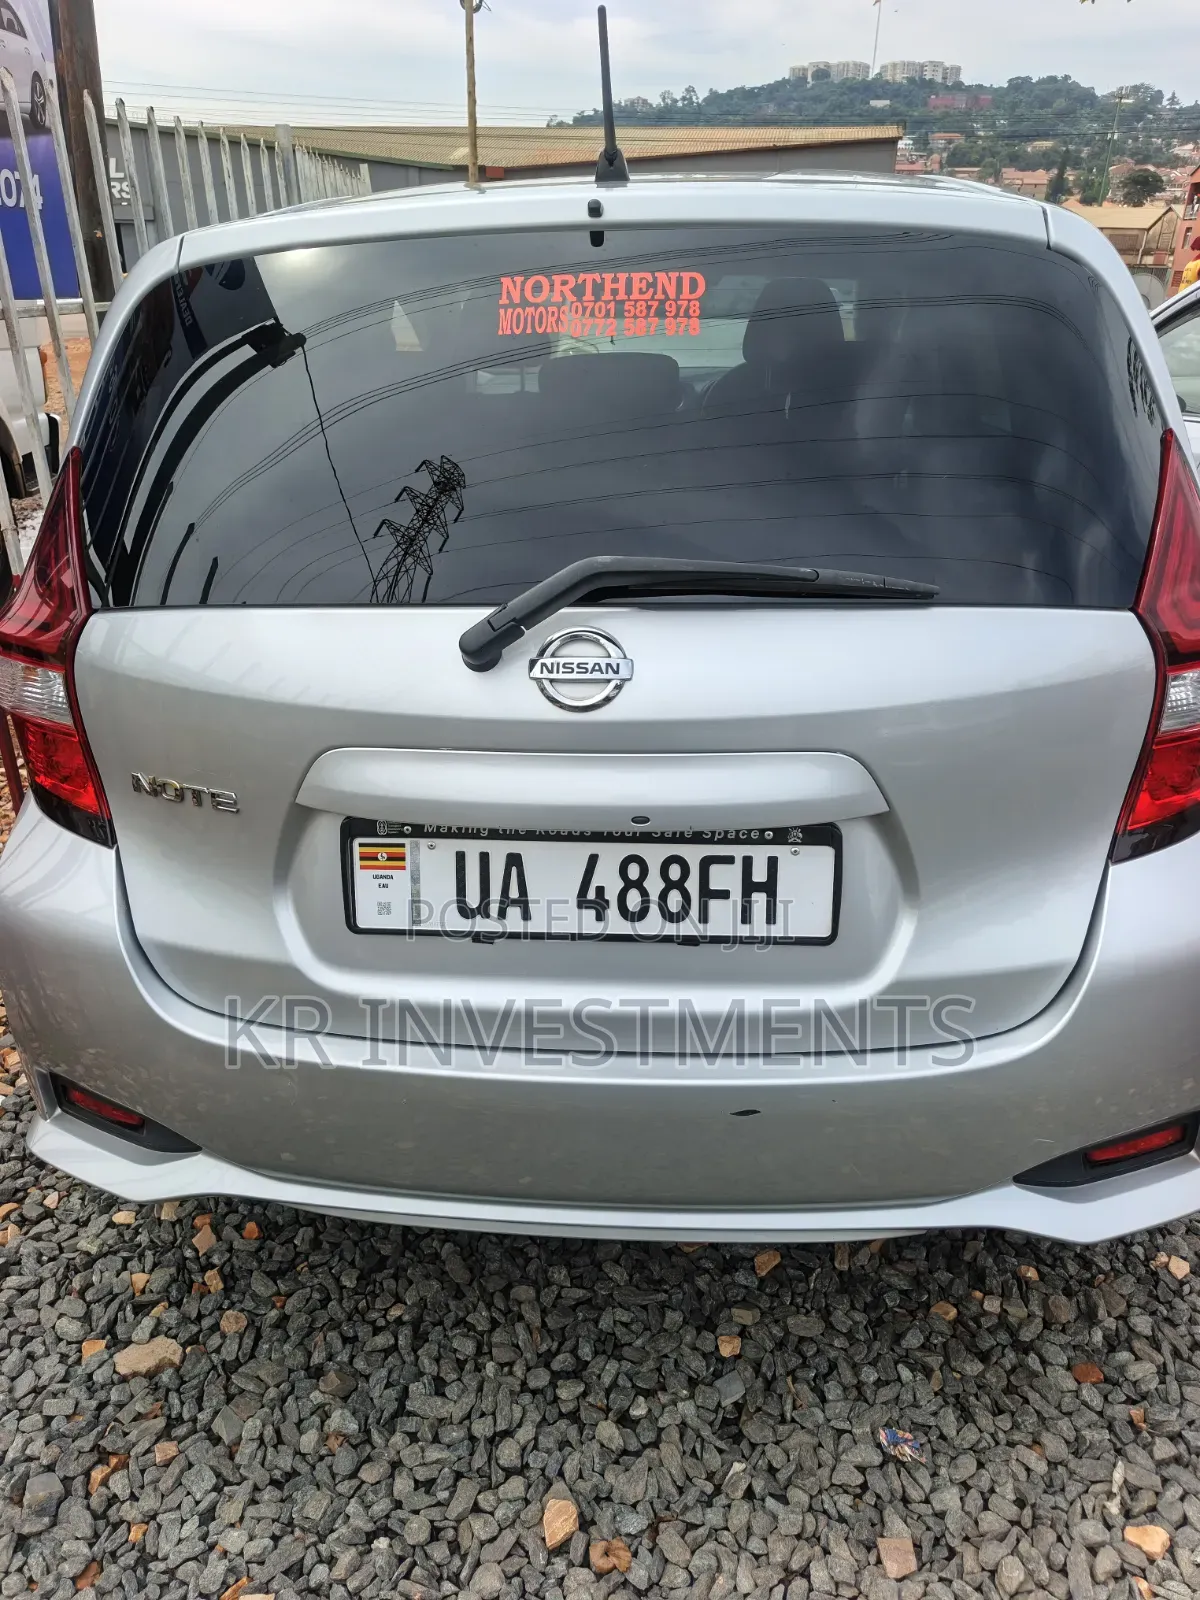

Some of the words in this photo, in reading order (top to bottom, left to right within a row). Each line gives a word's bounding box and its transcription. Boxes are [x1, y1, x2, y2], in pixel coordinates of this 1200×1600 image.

[499, 272, 706, 304] NORTHEND
[498, 304, 570, 335] MOTORS
[571, 301, 617, 319] 0701
[624, 301, 660, 318] 587
[665, 300, 701, 317] 978
[570, 318, 617, 337] 0772
[624, 318, 660, 336] 587
[665, 317, 701, 336] 978
[540, 662, 620, 675] NISSAN
[131, 771, 240, 813] NOTE
[455, 850, 532, 921] UA
[576, 853, 779, 925] 488FH
